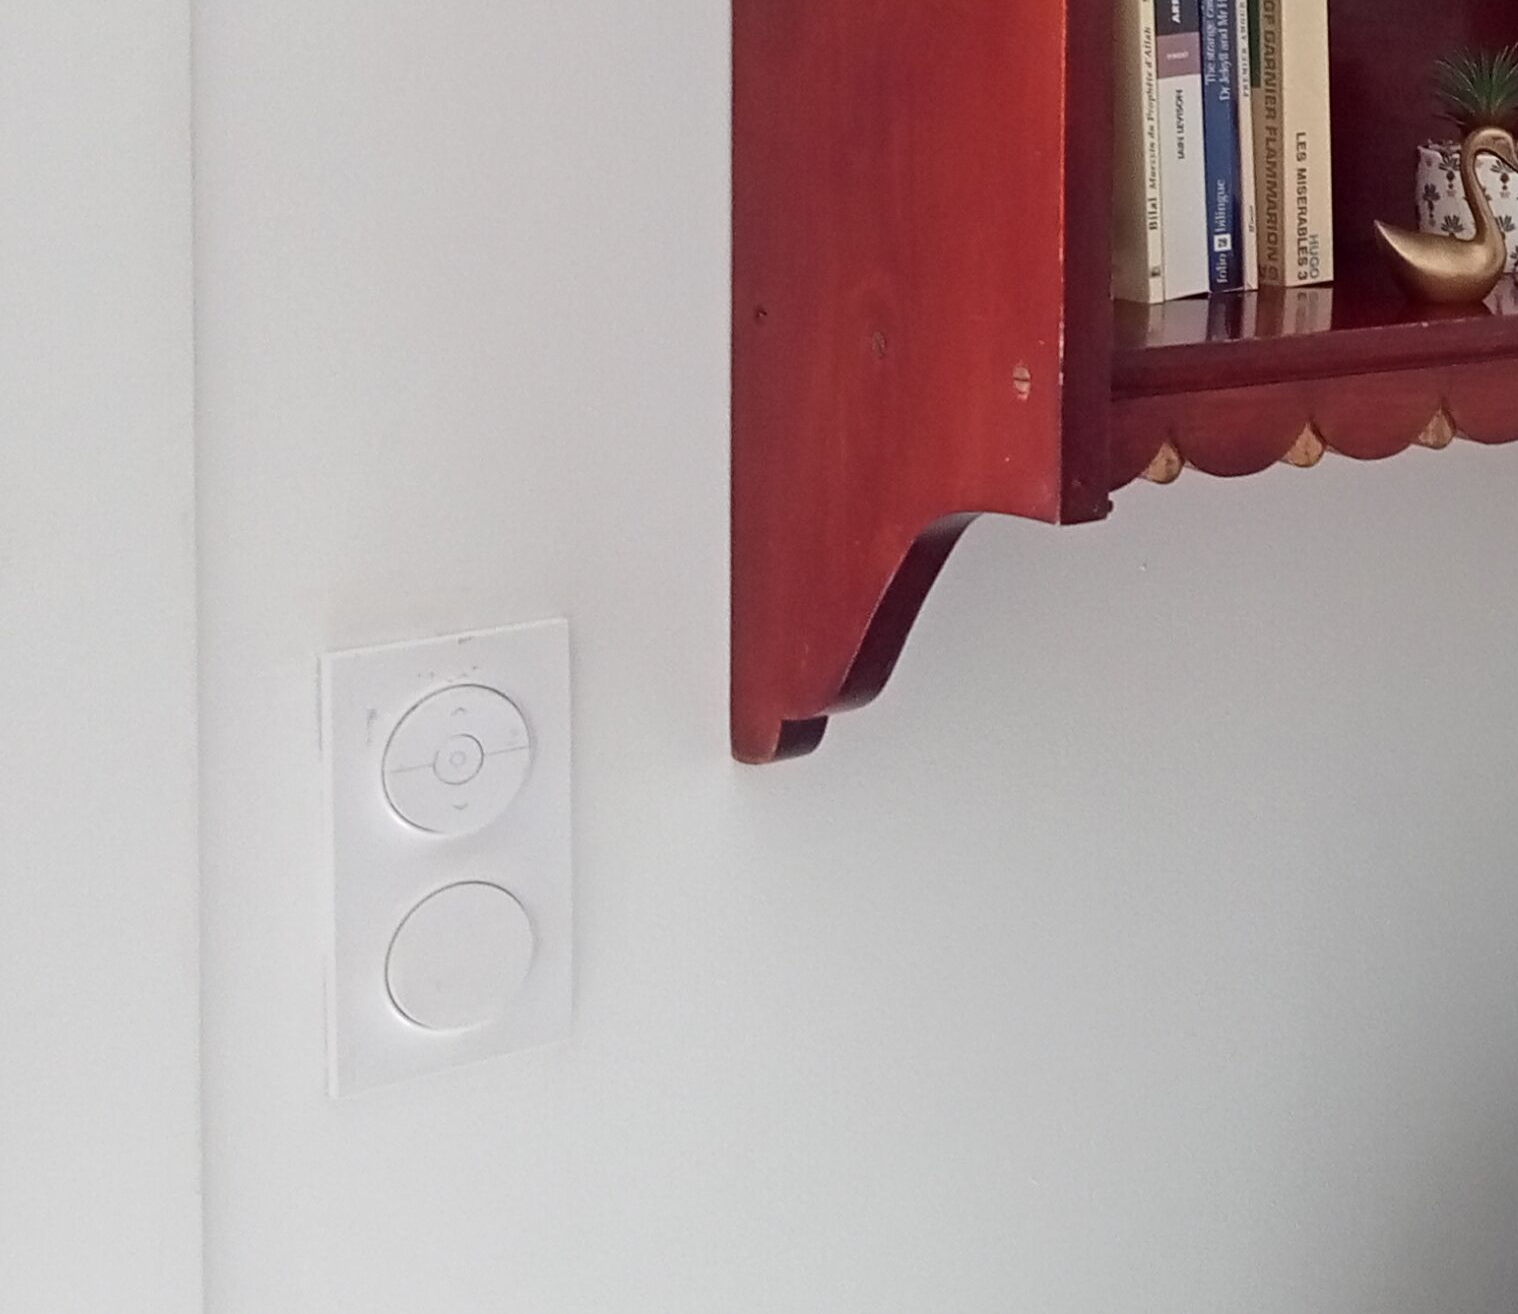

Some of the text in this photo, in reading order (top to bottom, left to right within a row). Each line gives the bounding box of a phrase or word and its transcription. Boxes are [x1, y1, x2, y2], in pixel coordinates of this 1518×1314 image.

[1216, 10, 1228, 26] Mr
[1204, 19, 1217, 61] strange
[1216, 28, 1229, 50] and
[1205, 63, 1216, 85] The
[1217, 53, 1231, 84] Jekyll
[1263, 29, 1278, 120] GARNIER
[1174, 88, 1186, 134] LEVISON
[1219, 86, 1231, 101] Dr
[1213, 178, 1229, 233] bilingue
[1265, 125, 1279, 261] FLAMMARION
[1296, 131, 1308, 281] LES MISERABLES 3
[1147, 196, 1158, 231] Bilal
[1215, 253, 1229, 284] folio
[1308, 234, 1320, 279] HUGO
